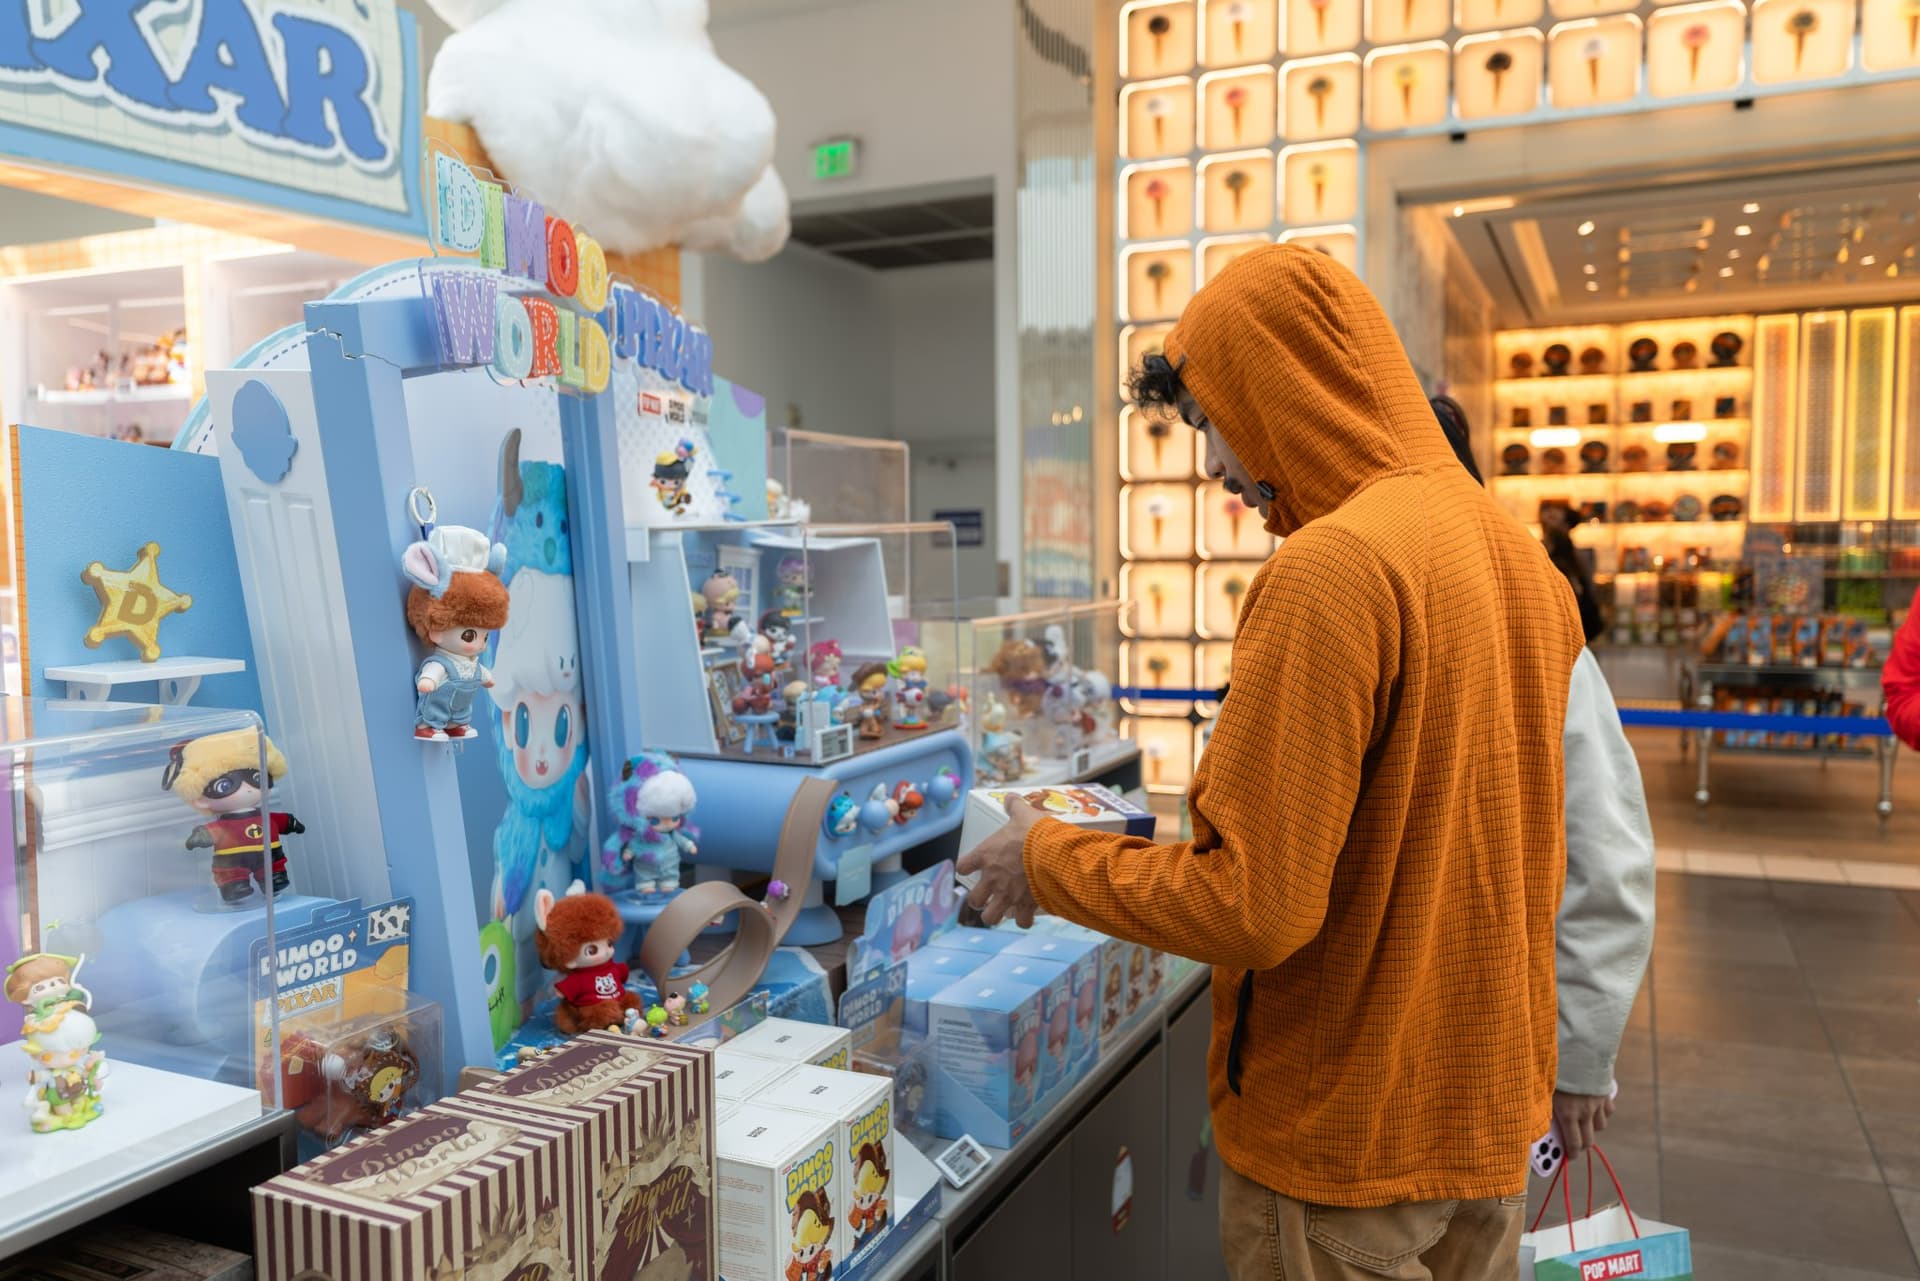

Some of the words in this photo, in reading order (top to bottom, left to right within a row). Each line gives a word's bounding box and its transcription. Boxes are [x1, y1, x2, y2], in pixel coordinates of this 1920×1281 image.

[0, 0, 391, 163] XAR
[436, 150, 607, 312] DIMOO
[432, 272, 611, 393] WORLD
[117, 581, 158, 626] D
[260, 933, 345, 977] DIMOO
[276, 948, 358, 988] WORLD
[522, 1051, 614, 1093] Dimoo
[552, 1051, 639, 1096] World
[849, 1098, 889, 1145] DIMOO
[341, 1125, 460, 1181] Dimoo
[375, 1123, 487, 1186] World
[787, 1140, 834, 1195] DIMOO
[1583, 1260, 1606, 1281] POP
[1607, 1254, 1640, 1276] MART
